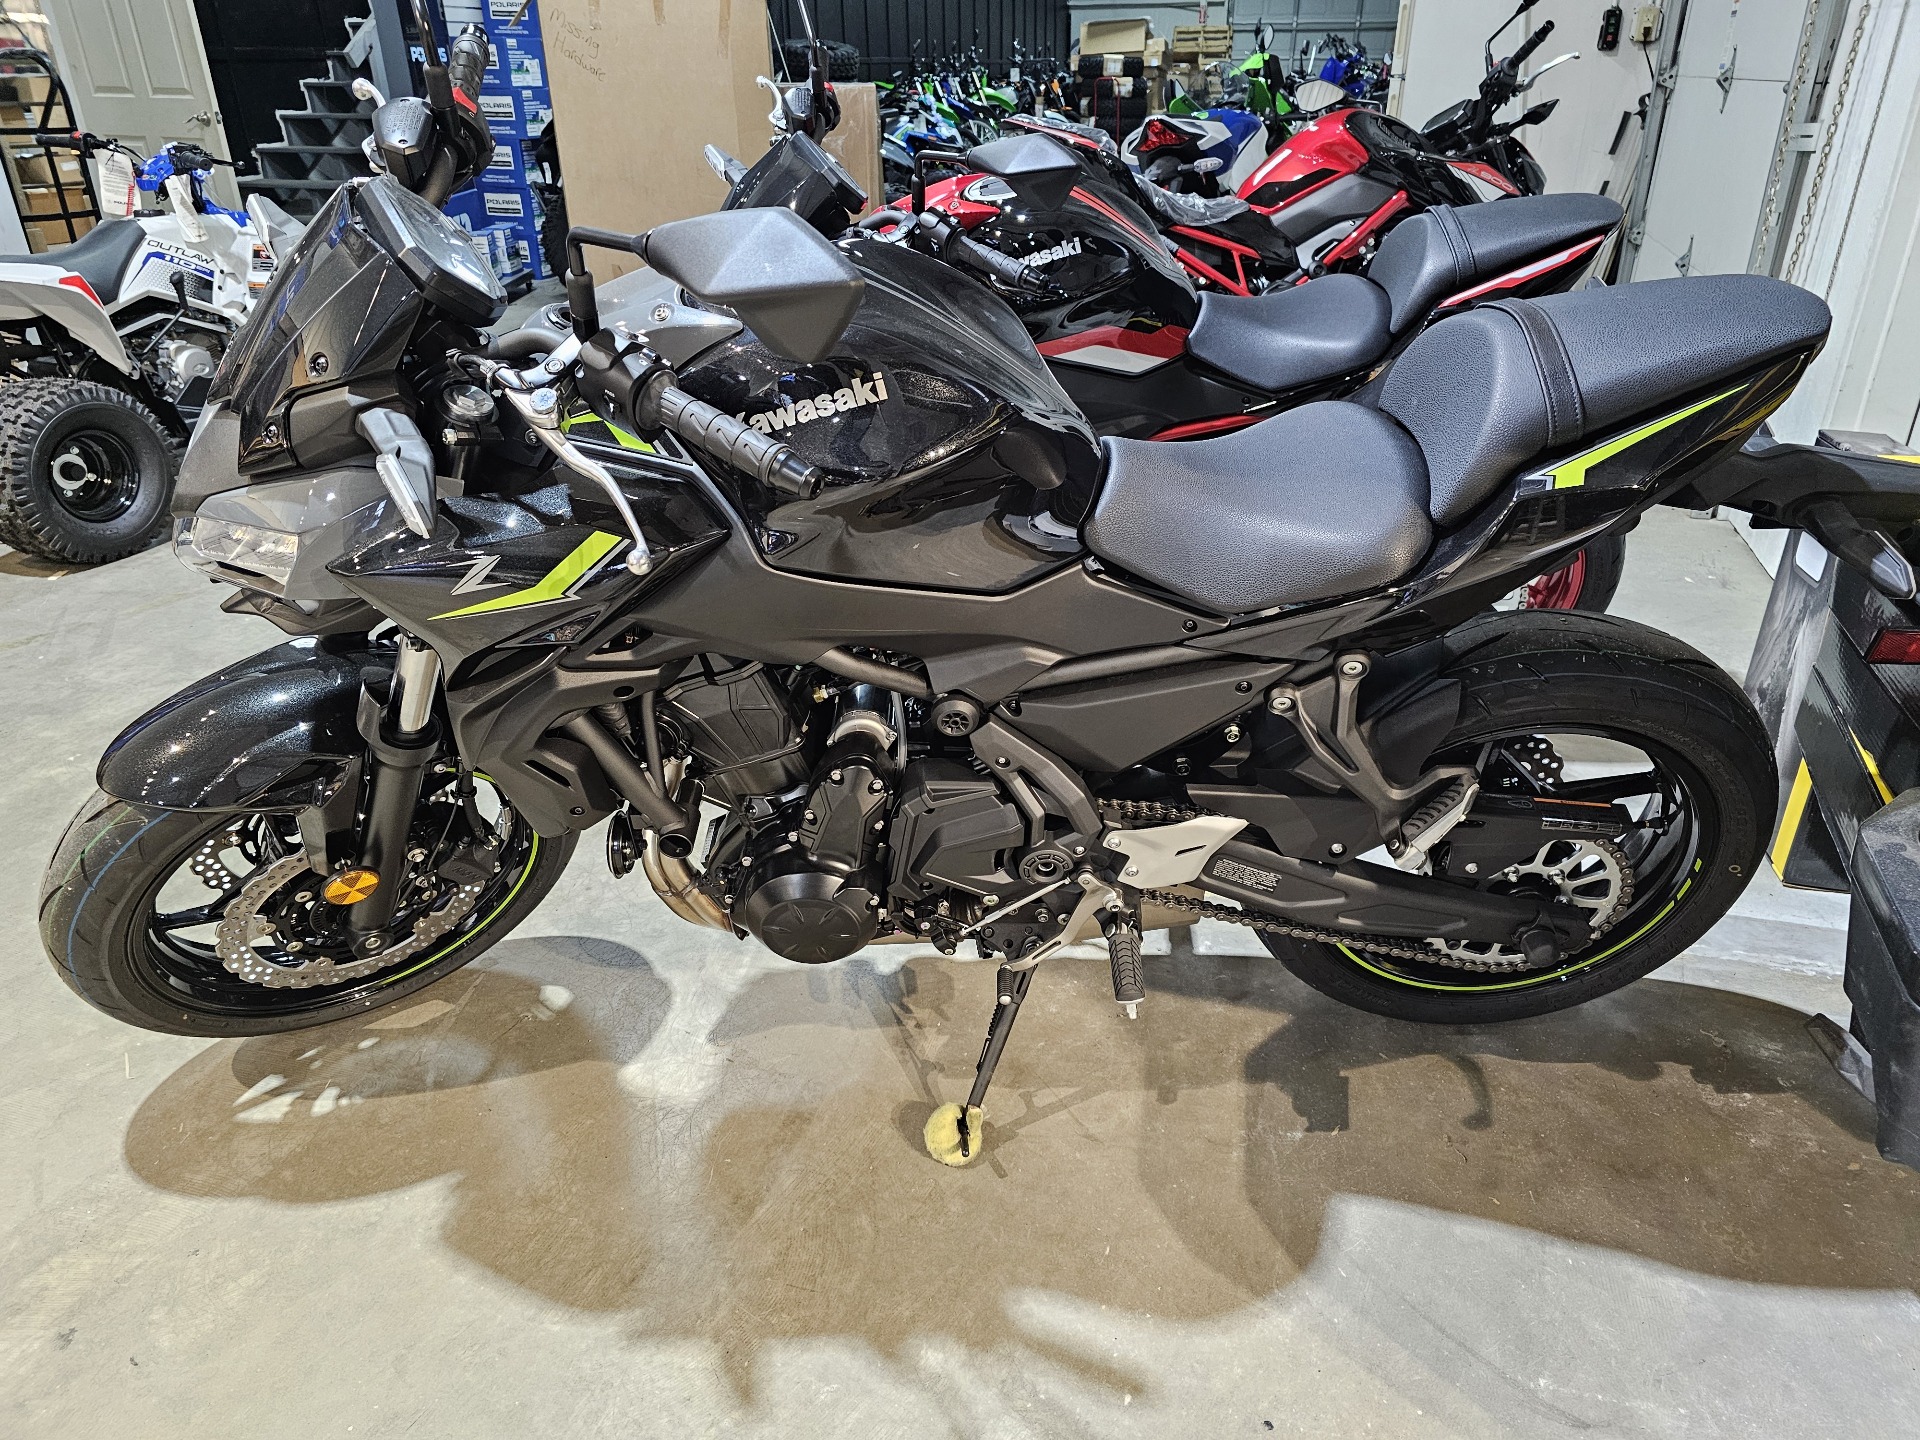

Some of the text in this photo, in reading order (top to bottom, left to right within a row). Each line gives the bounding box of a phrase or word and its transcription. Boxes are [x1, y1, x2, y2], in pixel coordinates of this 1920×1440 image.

[549, 7, 600, 60] Missing
[553, 31, 606, 82] Hardware
[147, 239, 215, 265] OUTLAW
[445, 554, 512, 596] Z
